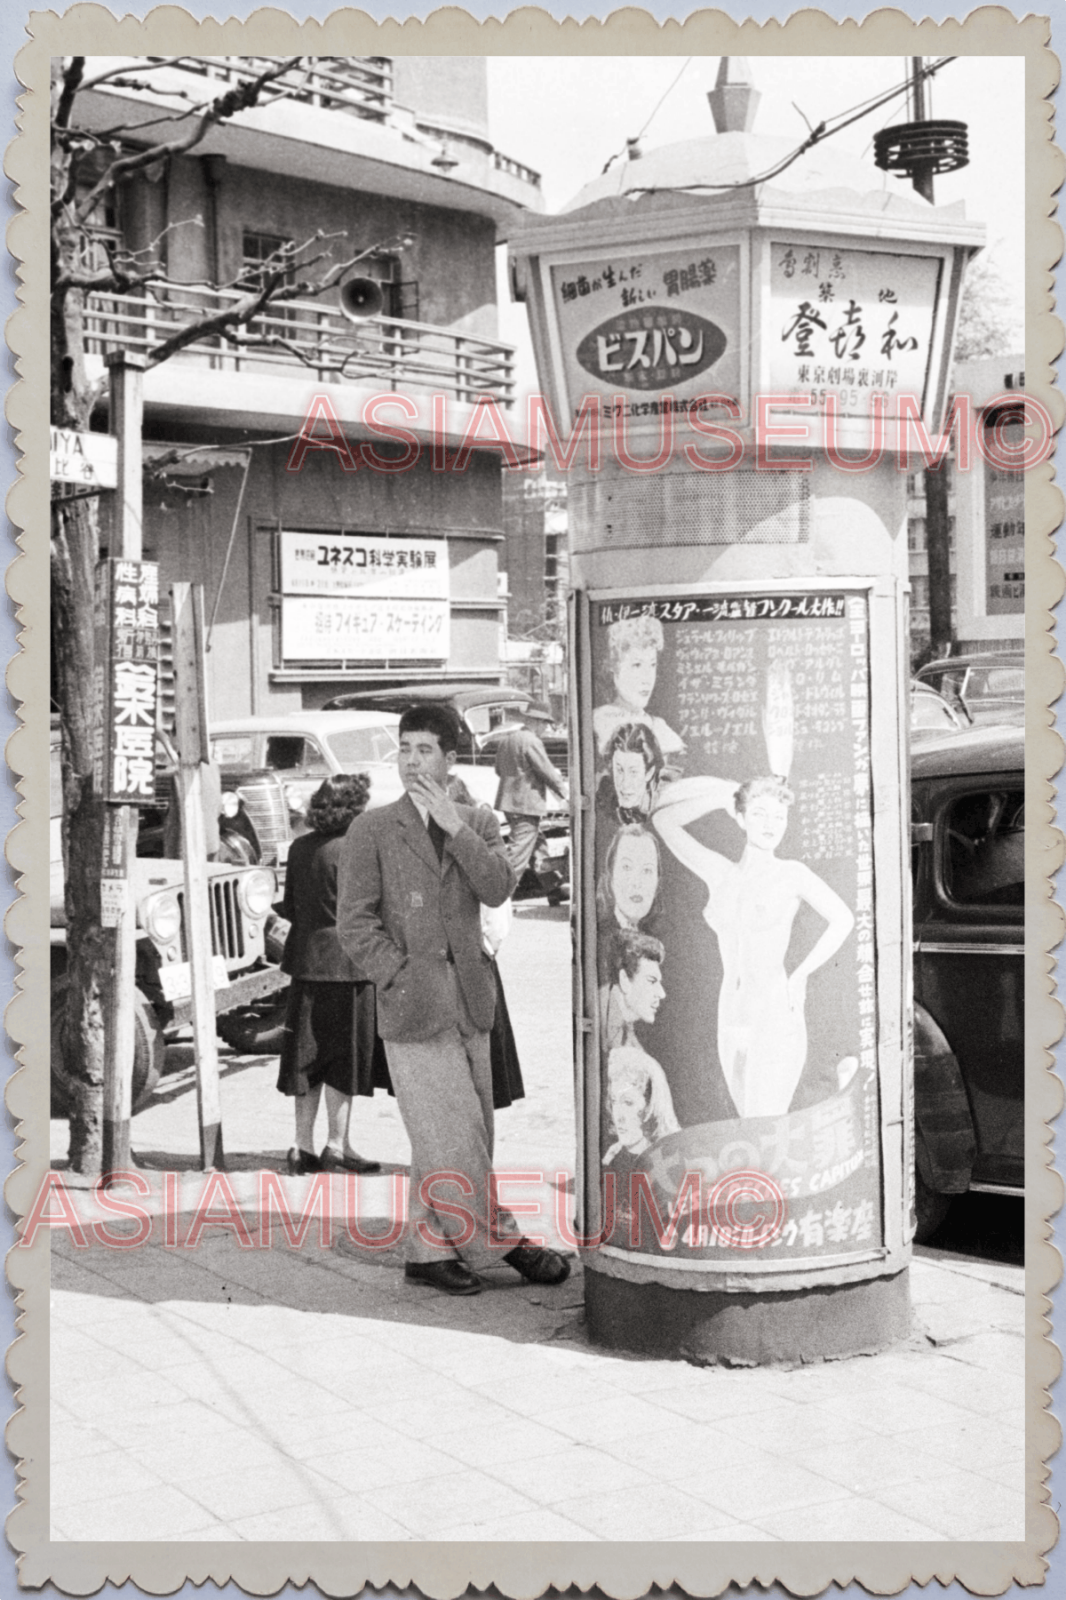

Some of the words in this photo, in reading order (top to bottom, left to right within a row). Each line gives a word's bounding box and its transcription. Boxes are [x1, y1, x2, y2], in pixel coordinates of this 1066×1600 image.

[561, 263, 643, 304] 細菌が生んだ
[663, 257, 717, 298] 胃腸薬
[596, 327, 704, 372] ビスパン
[50, 431, 84, 456] IYA
[317, 545, 438, 569] ユネスコ科学実験展
